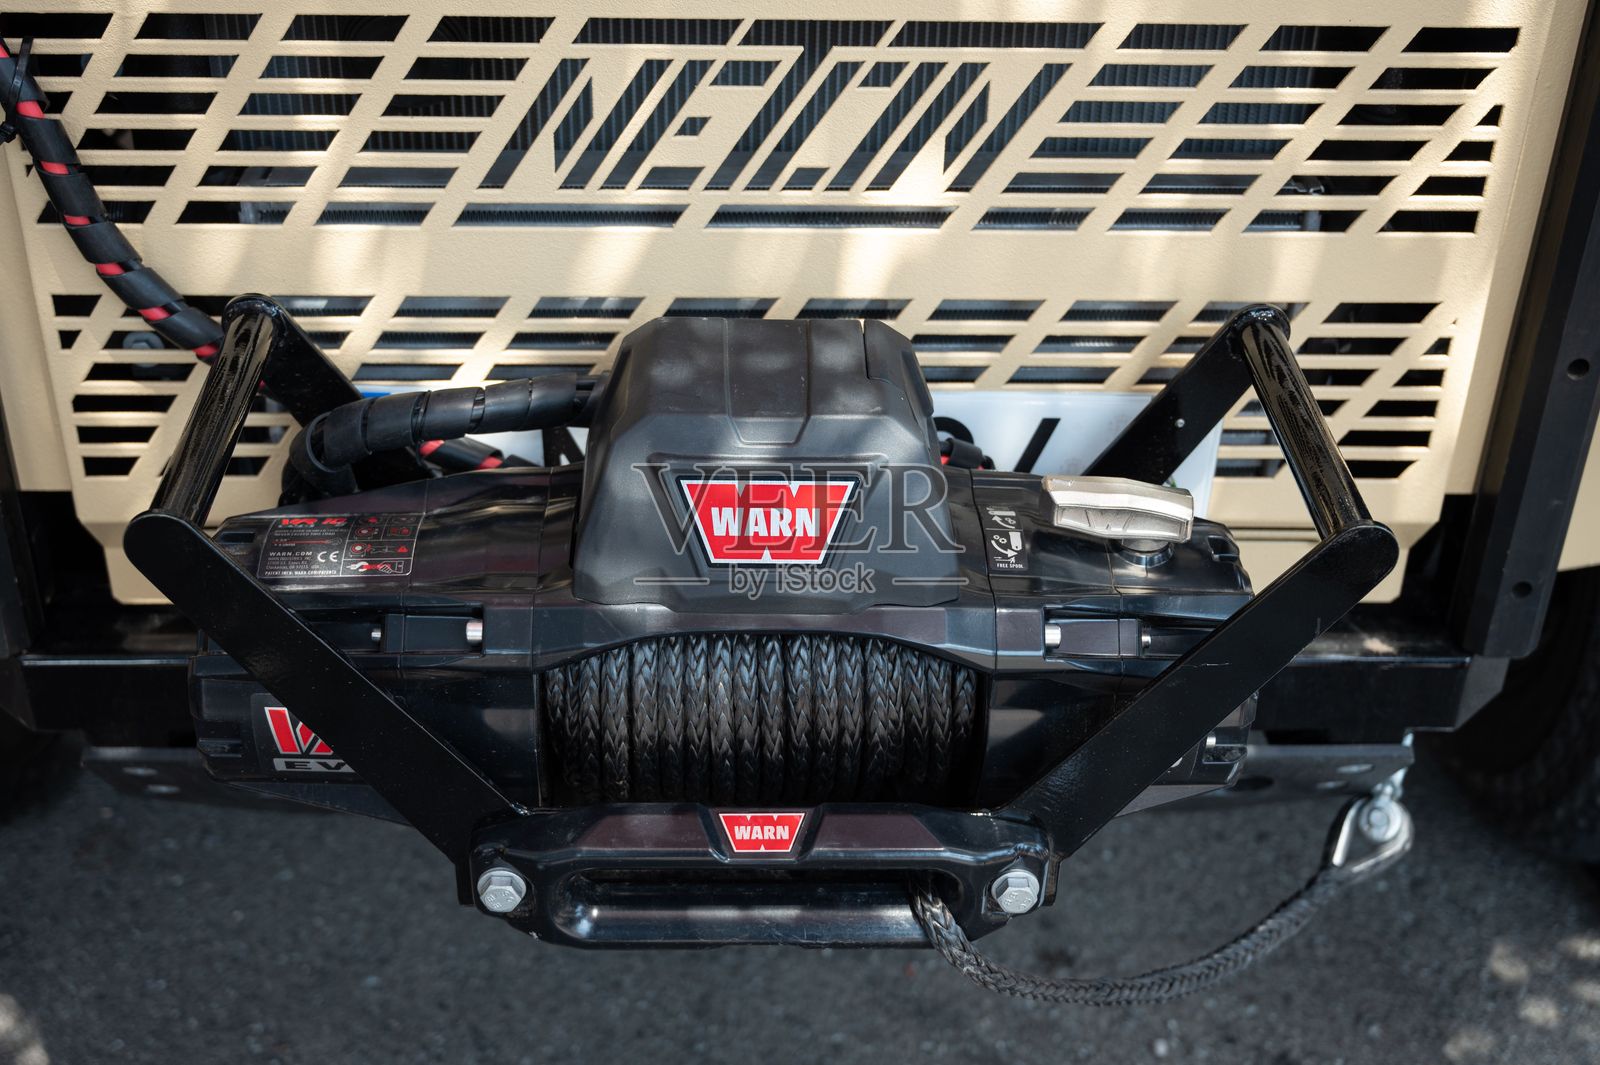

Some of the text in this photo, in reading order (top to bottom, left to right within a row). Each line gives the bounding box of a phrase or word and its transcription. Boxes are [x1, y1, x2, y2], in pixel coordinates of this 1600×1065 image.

[711, 507, 821, 538] WARN
[317, 550, 340, 563] CE
[733, 825, 790, 840] WARN
